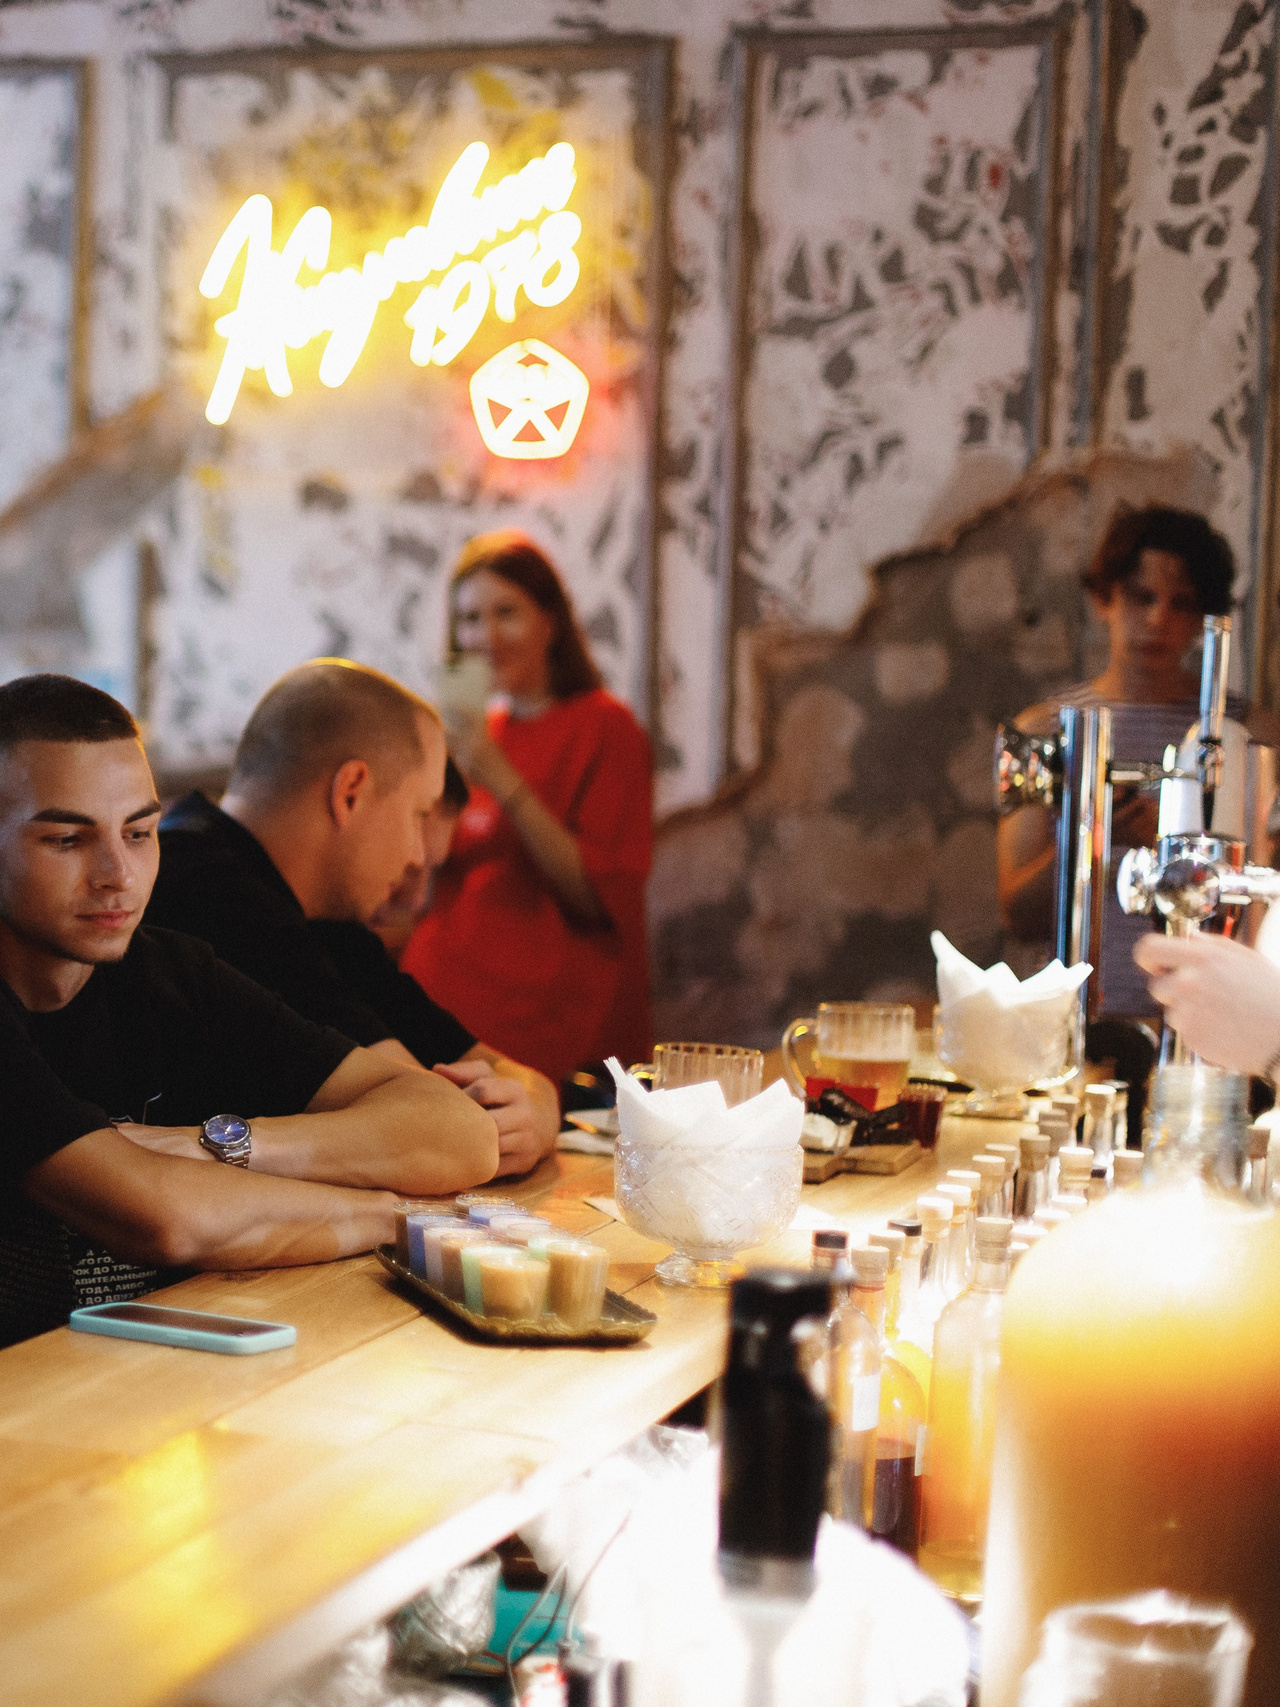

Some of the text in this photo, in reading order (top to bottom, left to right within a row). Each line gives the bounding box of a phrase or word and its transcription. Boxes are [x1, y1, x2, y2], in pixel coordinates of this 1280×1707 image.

[404, 211, 581, 366] 1978
[93, 1266, 110, 1275] ДО
[115, 1282, 145, 1291] ЛИБО
[86, 1296, 102, 1305] ДО
[105, 1292, 135, 1303] ДВУХ
